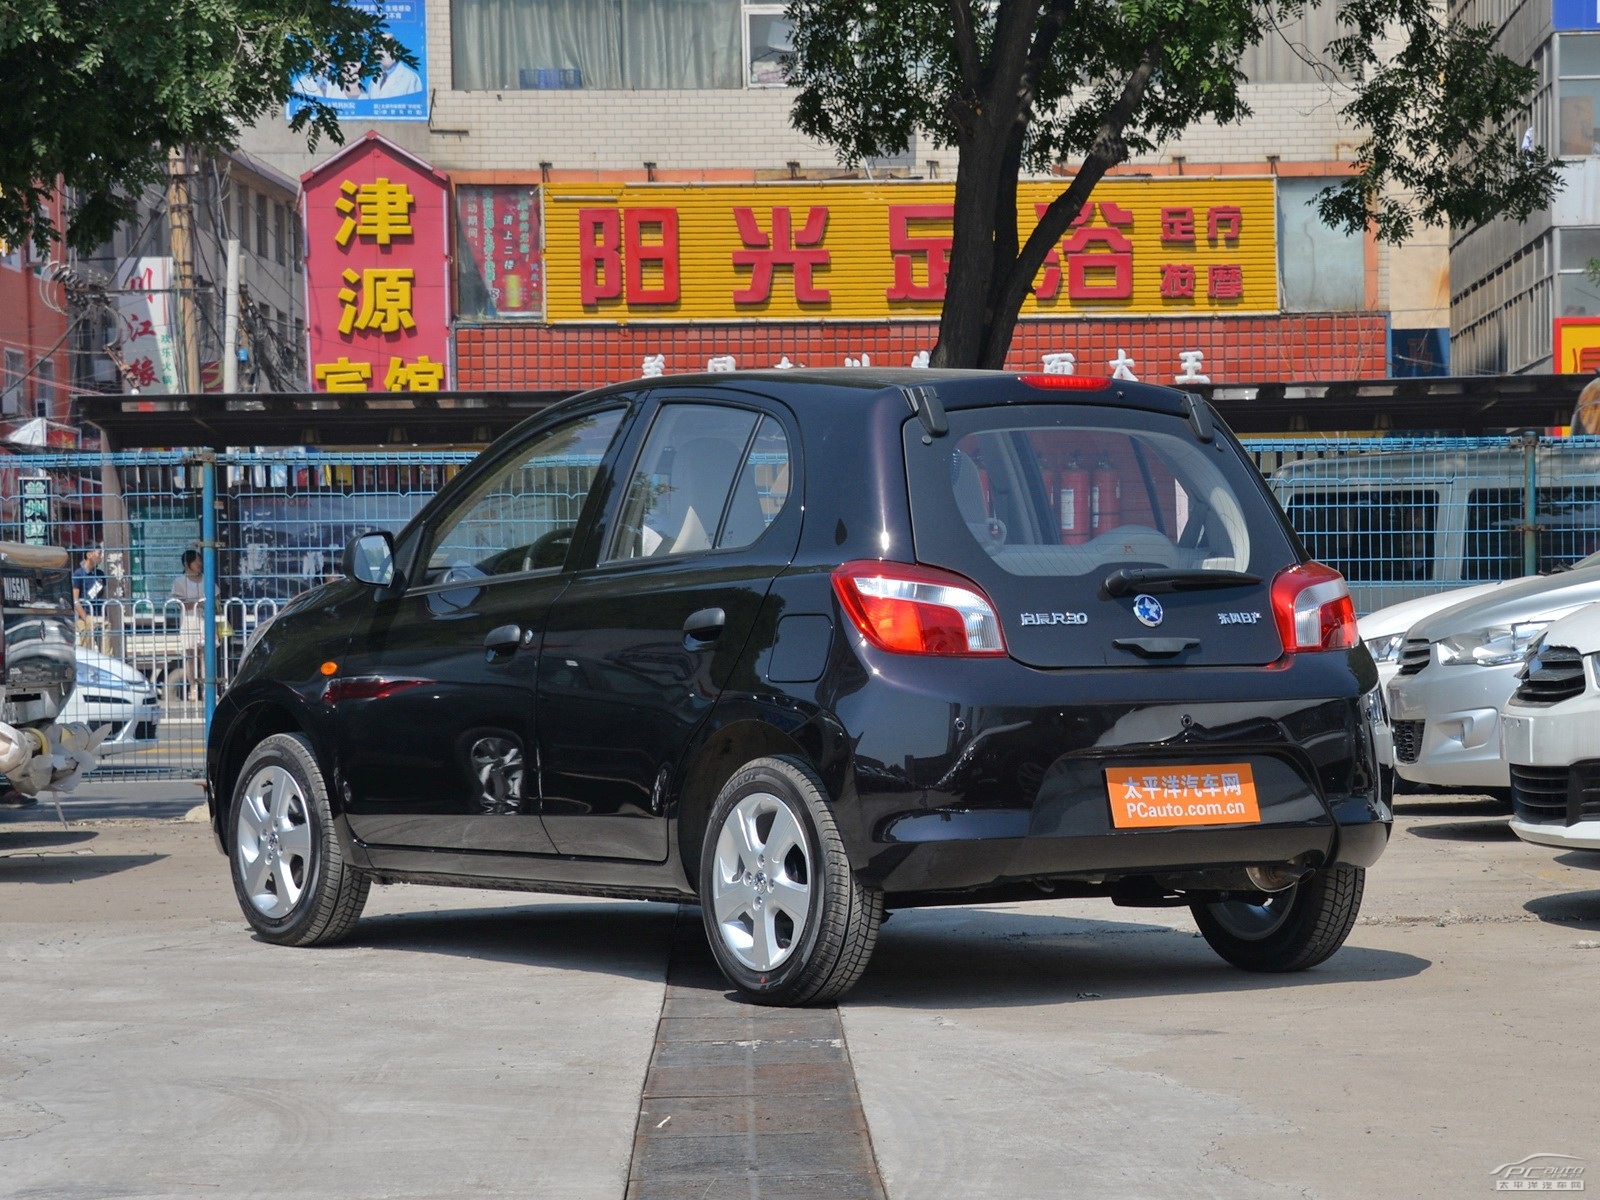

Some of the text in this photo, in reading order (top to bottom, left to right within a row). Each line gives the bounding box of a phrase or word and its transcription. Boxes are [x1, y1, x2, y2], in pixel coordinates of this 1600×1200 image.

[1160, 206, 1242, 241] 足疗
[335, 177, 416, 335] 津源
[1160, 264, 1244, 299] 按摩
[3, 577, 31, 602] NISSAN
[1217, 612, 1262, 624] 东风日产
[1122, 773, 1242, 800] 太平洋汽车网
[1126, 802, 1246, 819] PCauto.com.cn
